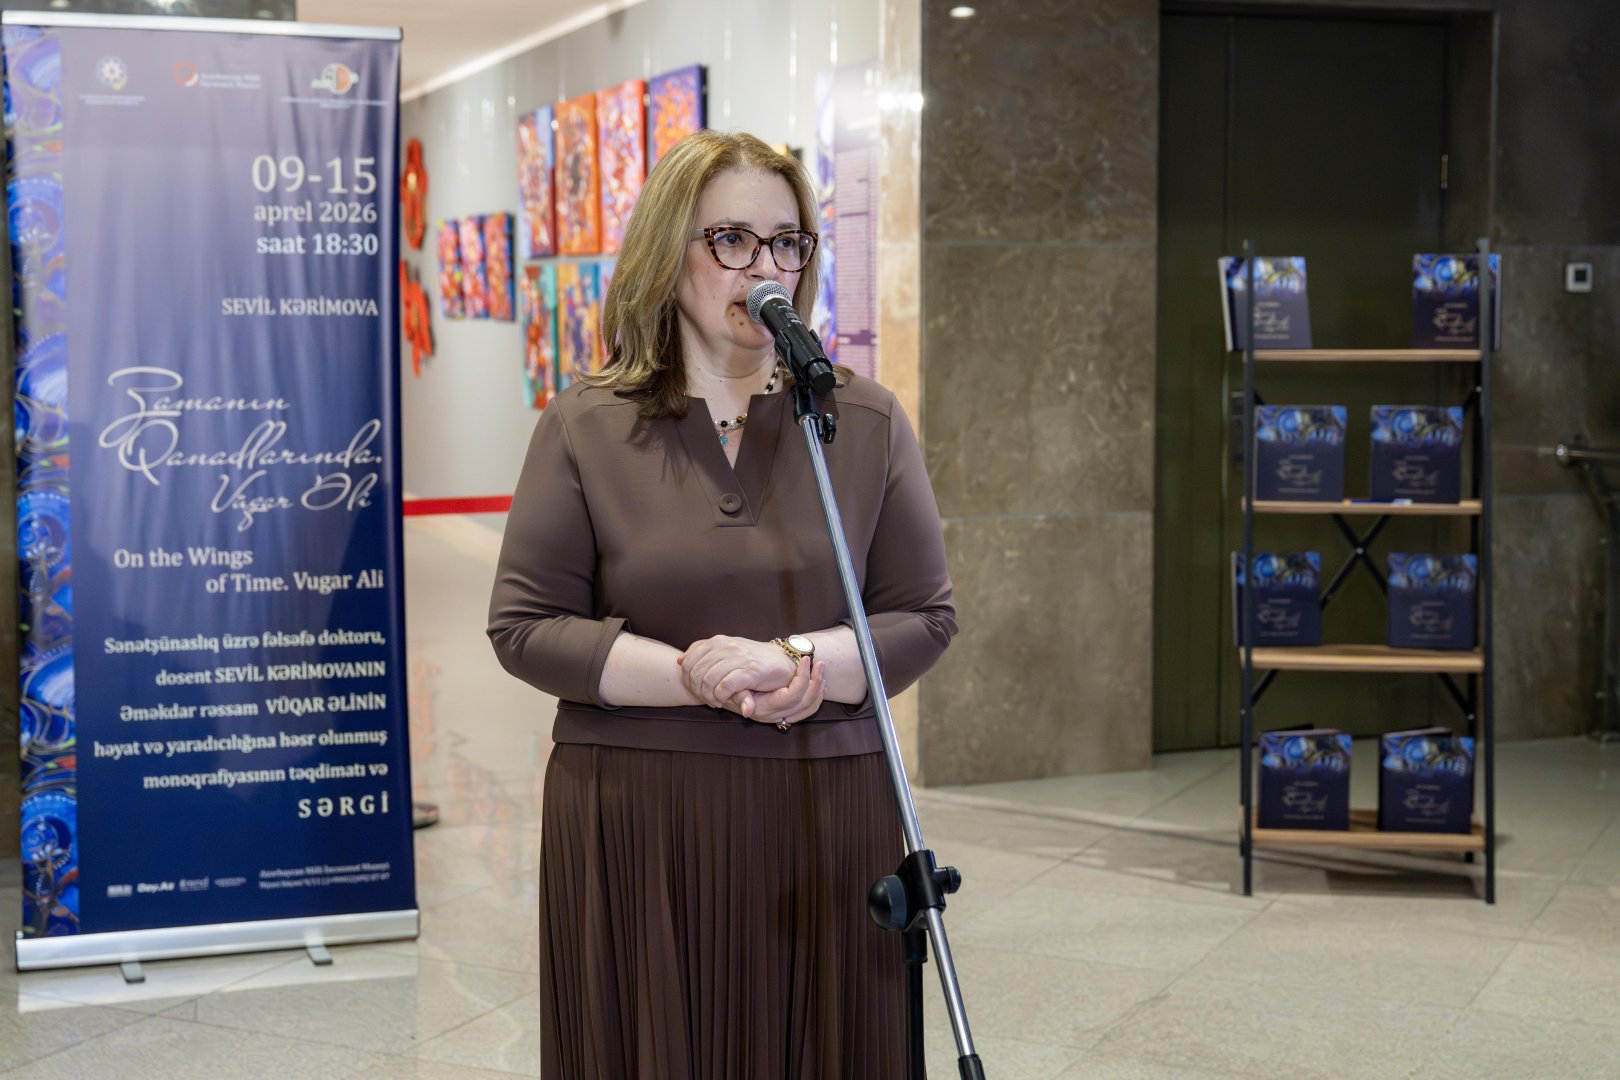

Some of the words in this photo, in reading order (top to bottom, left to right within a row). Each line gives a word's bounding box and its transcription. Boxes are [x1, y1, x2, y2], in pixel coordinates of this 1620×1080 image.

[252, 155, 376, 194] 09-15
[254, 201, 312, 226] aprel
[319, 202, 377, 224] 2026
[256, 235, 305, 254] saat
[312, 234, 378, 255] 18:30
[222, 297, 275, 316] SEVİL
[281, 298, 378, 317] KƏRİMOVA
[99, 367, 290, 448] Zamanın
[114, 549, 144, 568] On
[149, 548, 183, 567] the
[189, 547, 253, 568] Wings
[206, 573, 230, 593] of
[231, 573, 289, 592] Time.
[294, 572, 352, 594] Vugar
[357, 570, 384, 589] Ali
[223, 633, 259, 650] üzrə
[262, 631, 314, 648] fəlsəfə
[318, 629, 385, 647] doktoru,
[156, 669, 212, 686] dosent
[215, 665, 264, 684] SEVİL
[267, 661, 385, 680] KƏRİMOVANIN
[120, 701, 196, 722] Əməkdar
[200, 702, 258, 719] rəssam
[266, 696, 324, 716] VÜQAR
[327, 693, 386, 711] ƏLİNİN
[94, 741, 139, 760] həyat
[144, 743, 163, 753] və
[166, 737, 276, 757] yaradıcılığına
[280, 733, 314, 750] həsr
[318, 728, 387, 748] olunmuş
[143, 770, 285, 789] monoqrafiyasının
[289, 765, 366, 782] təqdimatı
[369, 764, 387, 776] və
